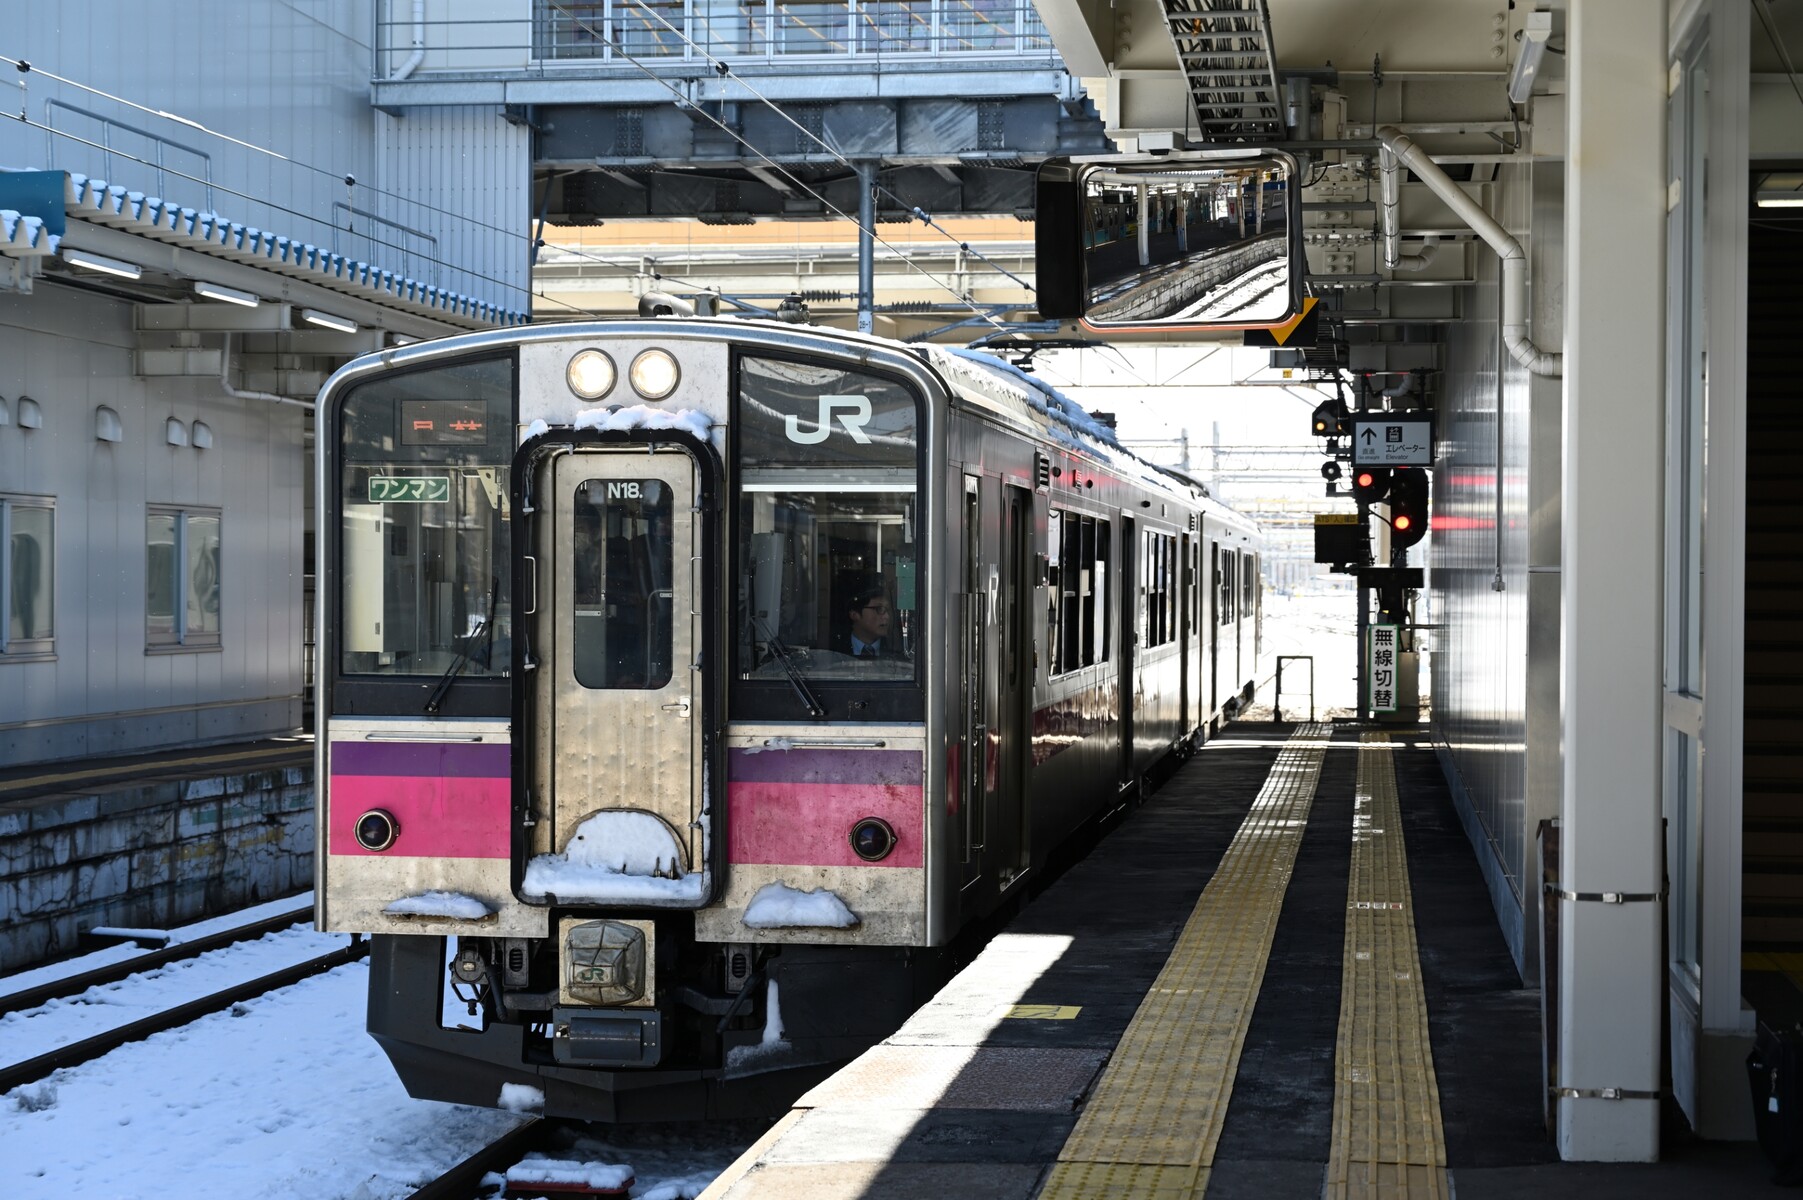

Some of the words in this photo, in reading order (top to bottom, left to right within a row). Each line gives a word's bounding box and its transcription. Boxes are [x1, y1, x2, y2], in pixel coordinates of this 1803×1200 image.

[785, 395, 872, 445] JR
[1386, 445, 1425, 453] エレベーター
[372, 480, 446, 499] ワンマン
[1374, 629, 1393, 708] 無線切替
[582, 968, 604, 981] JR
